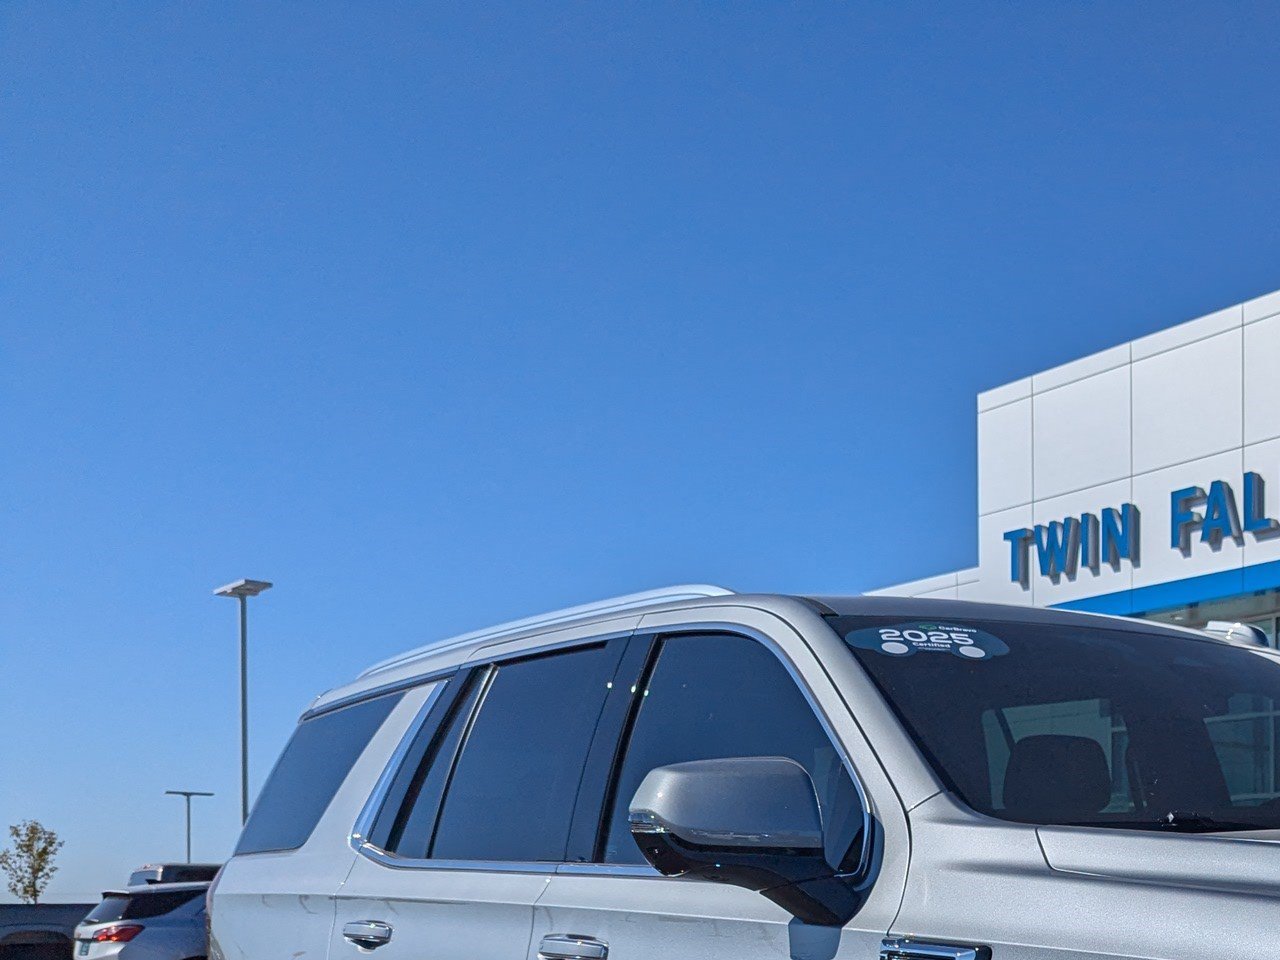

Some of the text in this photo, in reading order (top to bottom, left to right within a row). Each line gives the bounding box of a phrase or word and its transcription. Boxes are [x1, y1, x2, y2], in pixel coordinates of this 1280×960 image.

[1003, 503, 1141, 592] TWIN
[878, 628, 974, 645] 2025
[912, 641, 951, 649] Certified
